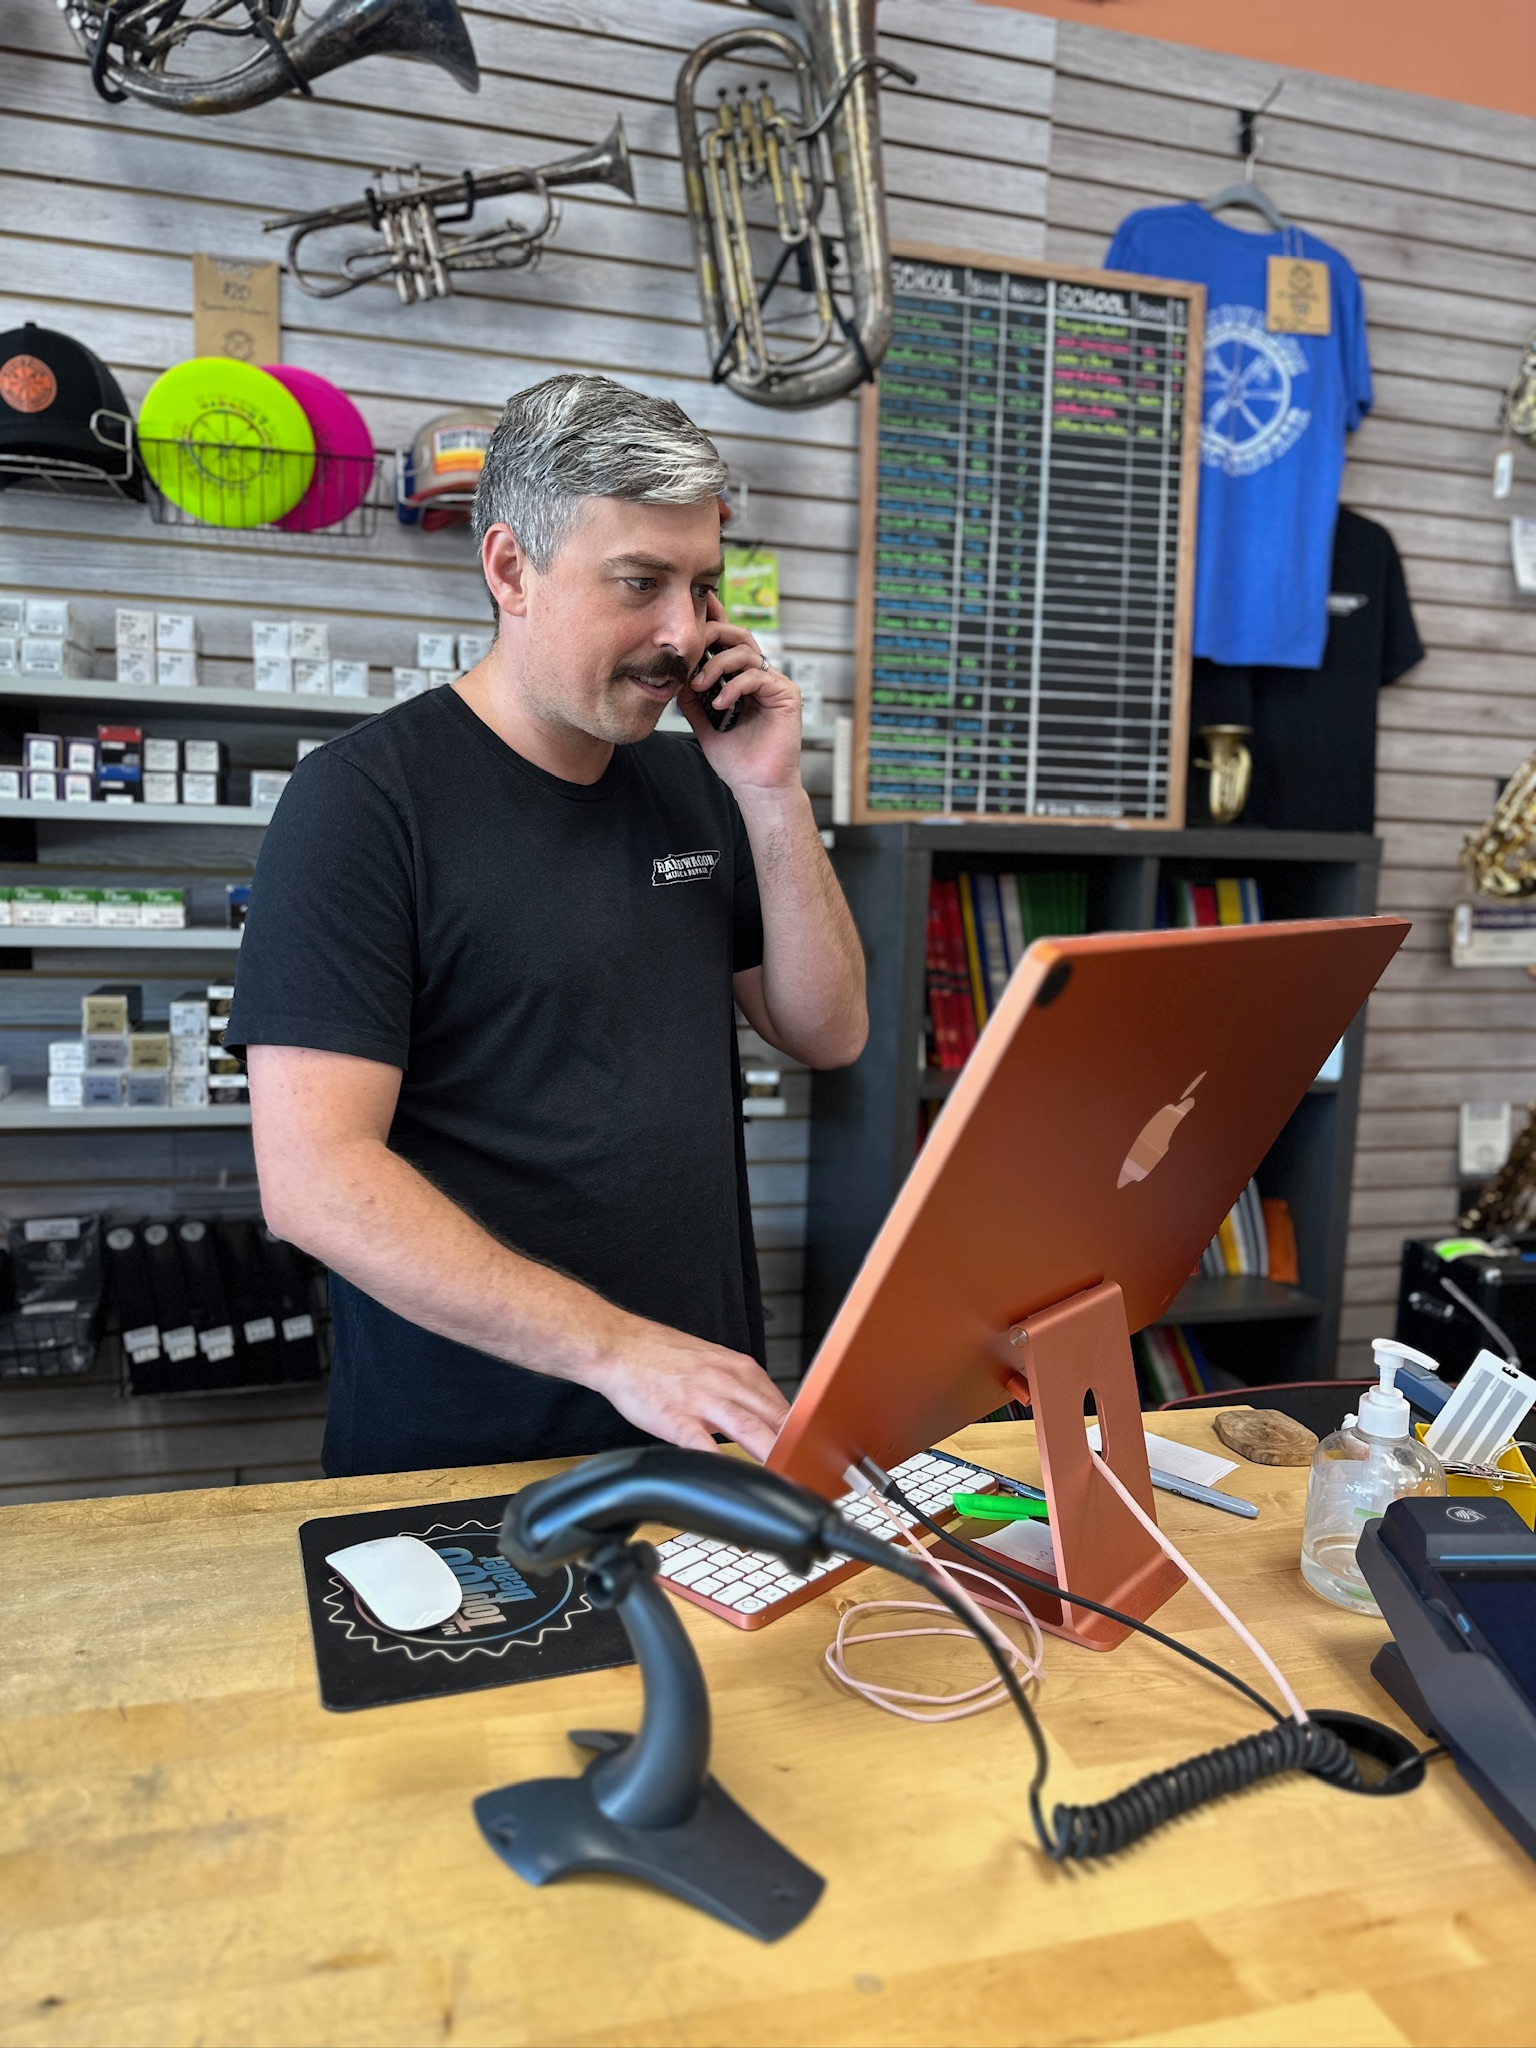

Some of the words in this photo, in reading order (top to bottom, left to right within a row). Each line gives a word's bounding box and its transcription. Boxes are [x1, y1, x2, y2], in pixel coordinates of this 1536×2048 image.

[656, 855, 714, 873] BANDWAGON
[687, 867, 708, 876] REPAIR
[477, 1555, 537, 1604] Dealer
